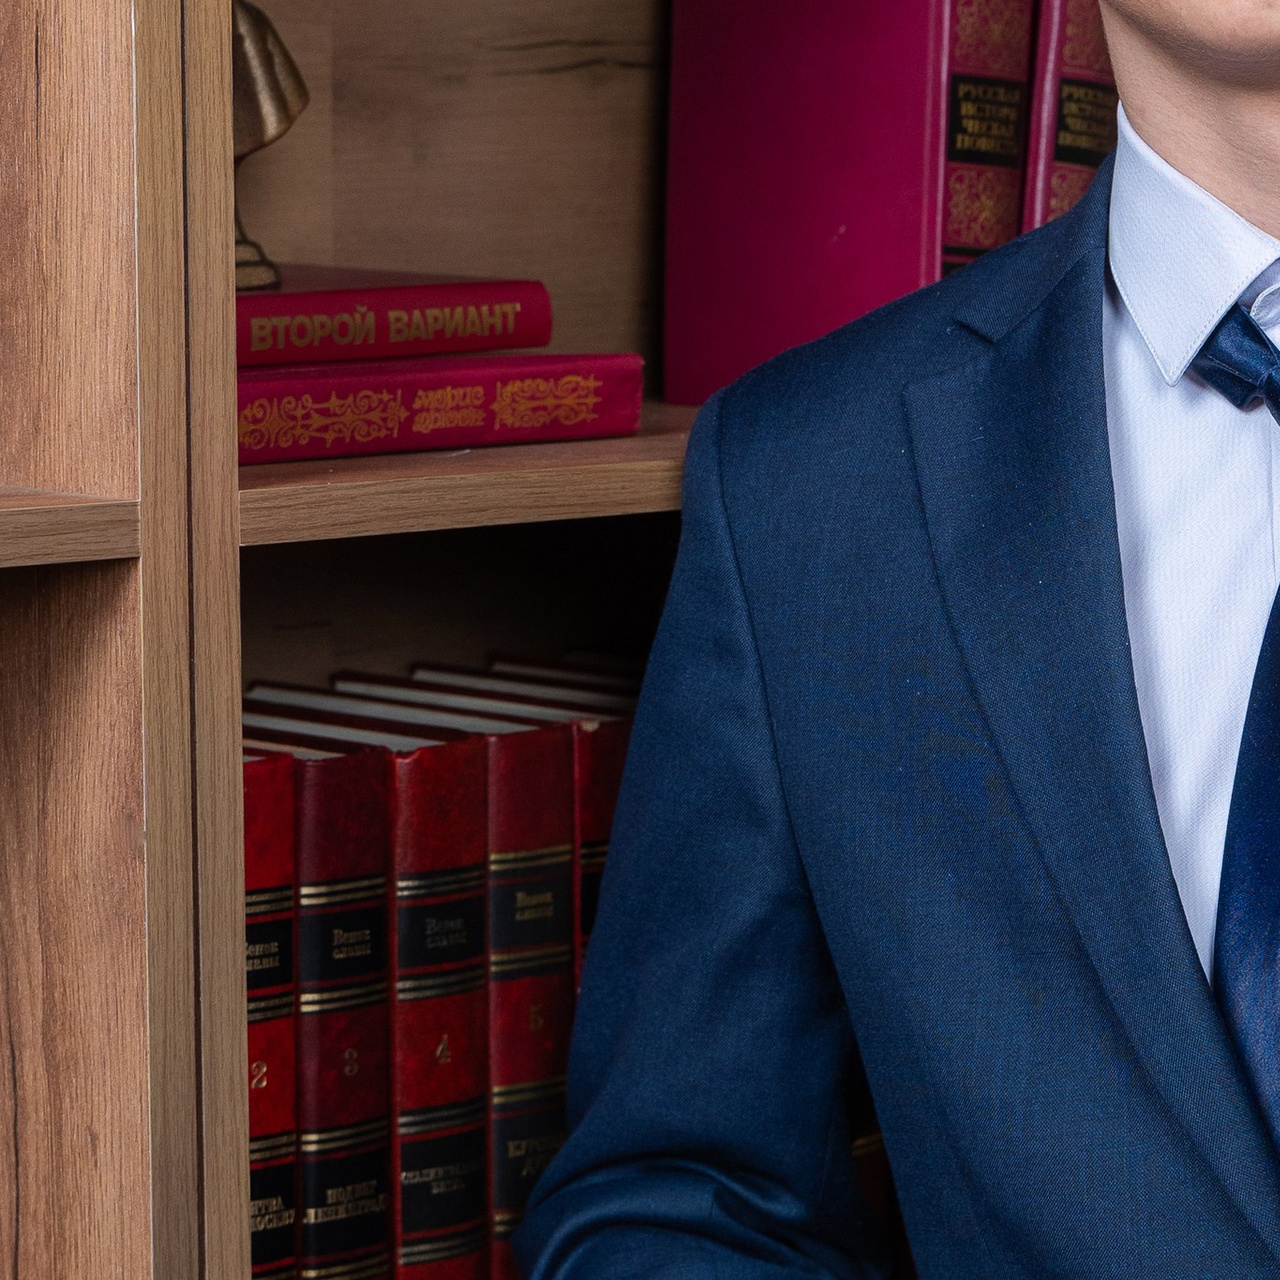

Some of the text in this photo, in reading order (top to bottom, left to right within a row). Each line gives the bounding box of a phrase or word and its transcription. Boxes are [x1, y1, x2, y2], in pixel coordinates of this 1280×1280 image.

[250, 302, 521, 351] ВТОРОЙ ВАРИАНТ
[246, 941, 279, 956] енок
[344, 1048, 358, 1076] 3
[436, 1034, 451, 1064] 4
[251, 1061, 267, 1089] 2
